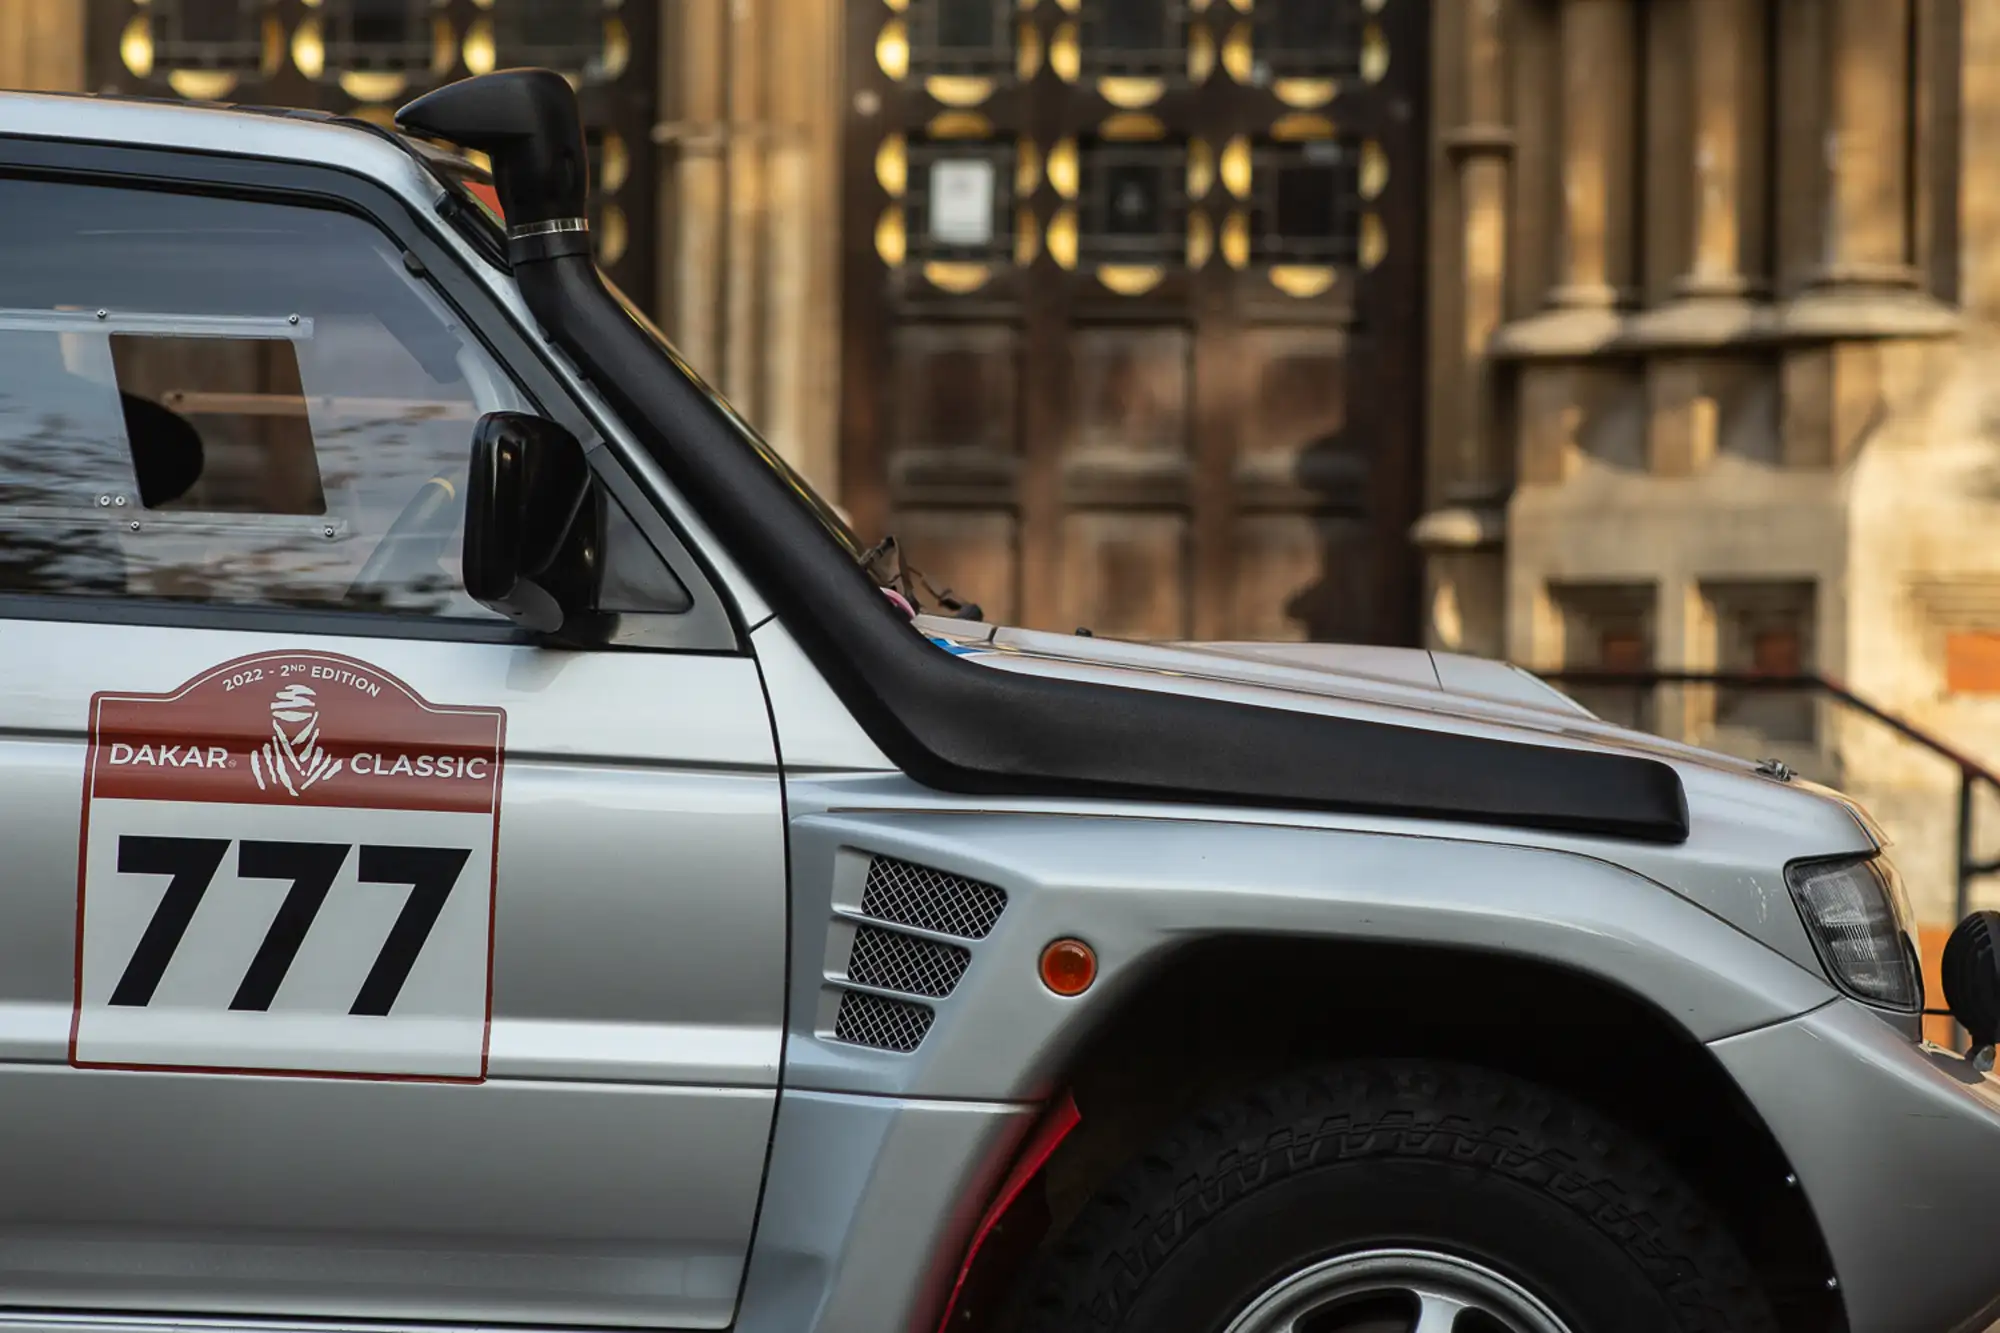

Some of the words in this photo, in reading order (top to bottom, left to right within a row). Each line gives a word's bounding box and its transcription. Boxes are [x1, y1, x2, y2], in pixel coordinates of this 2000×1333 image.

[222, 668, 264, 692] 2022
[280, 664, 306, 678] 2ND
[311, 666, 381, 698] EDITION
[109, 743, 228, 769] DAKAR
[350, 753, 488, 780] CLASSIC
[108, 835, 473, 1017] 777
